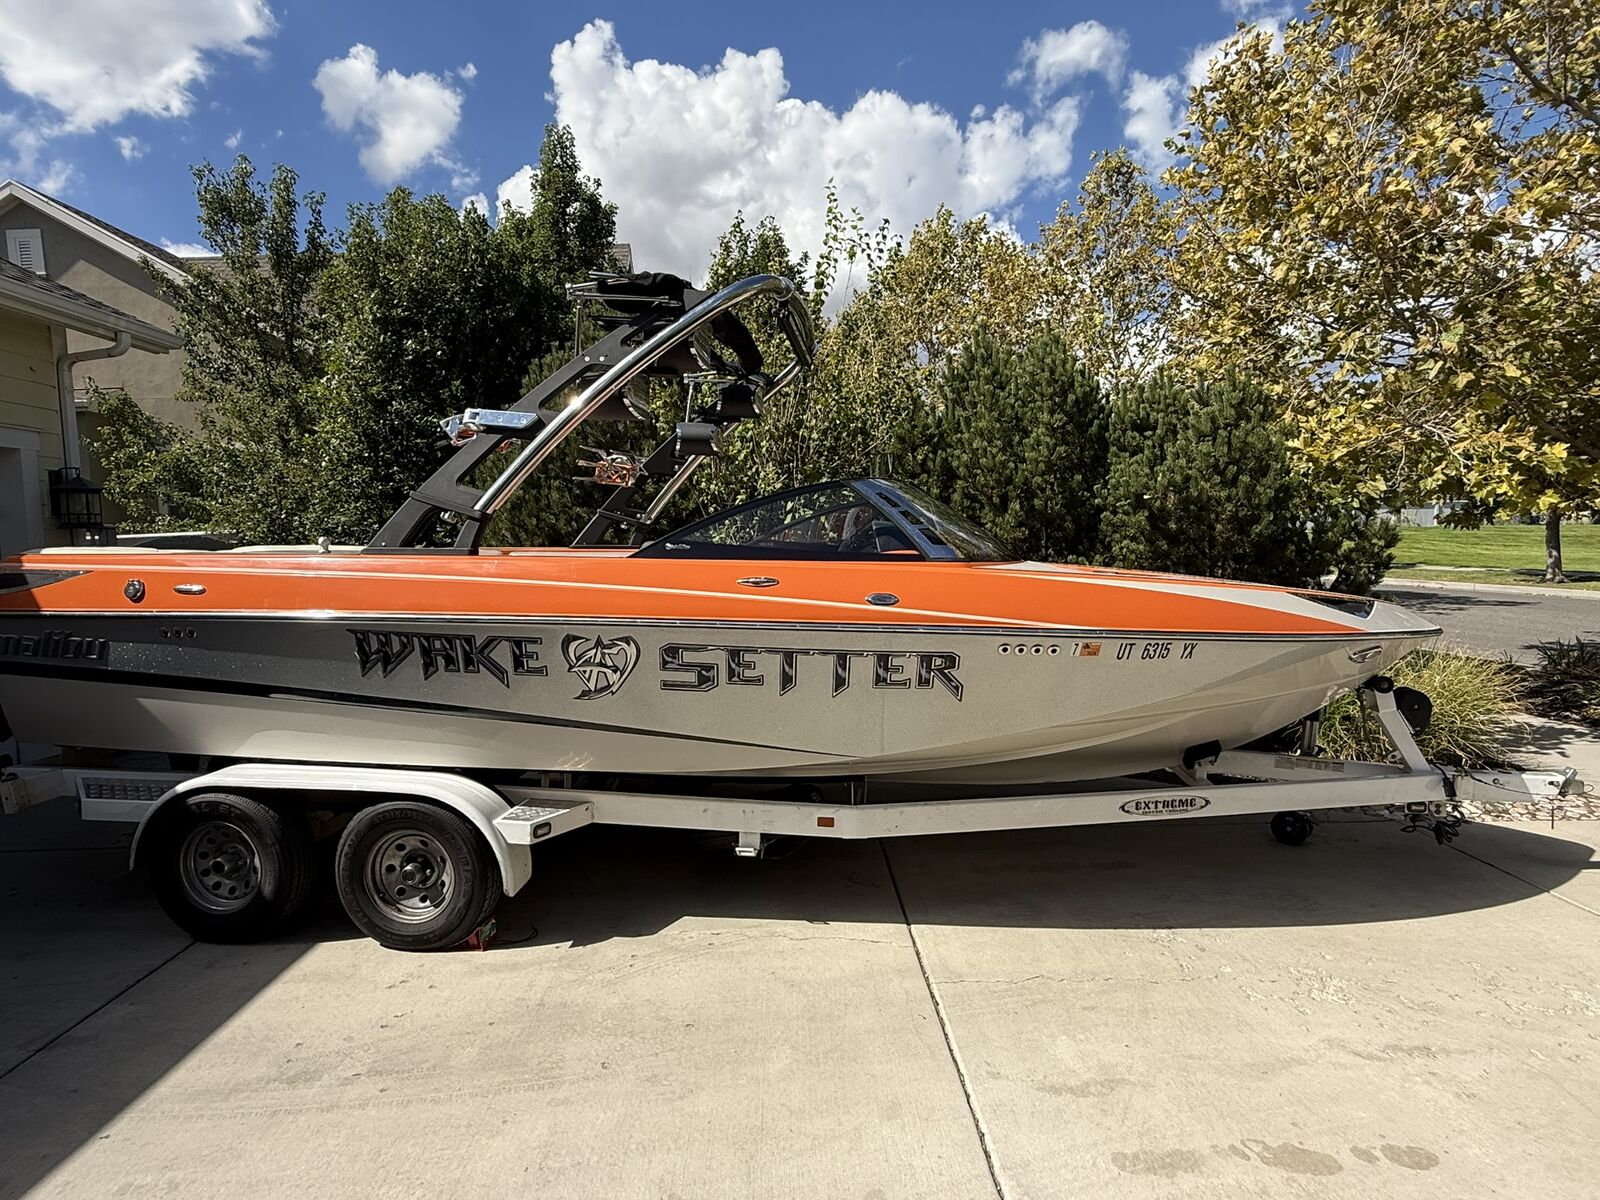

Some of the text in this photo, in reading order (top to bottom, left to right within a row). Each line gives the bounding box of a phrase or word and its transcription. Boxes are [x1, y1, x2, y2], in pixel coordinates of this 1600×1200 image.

[1116, 642, 1198, 660] UT 6315 YX
[346, 628, 963, 702] WAKE SETTER
[1134, 797, 1197, 811] EXTREME
